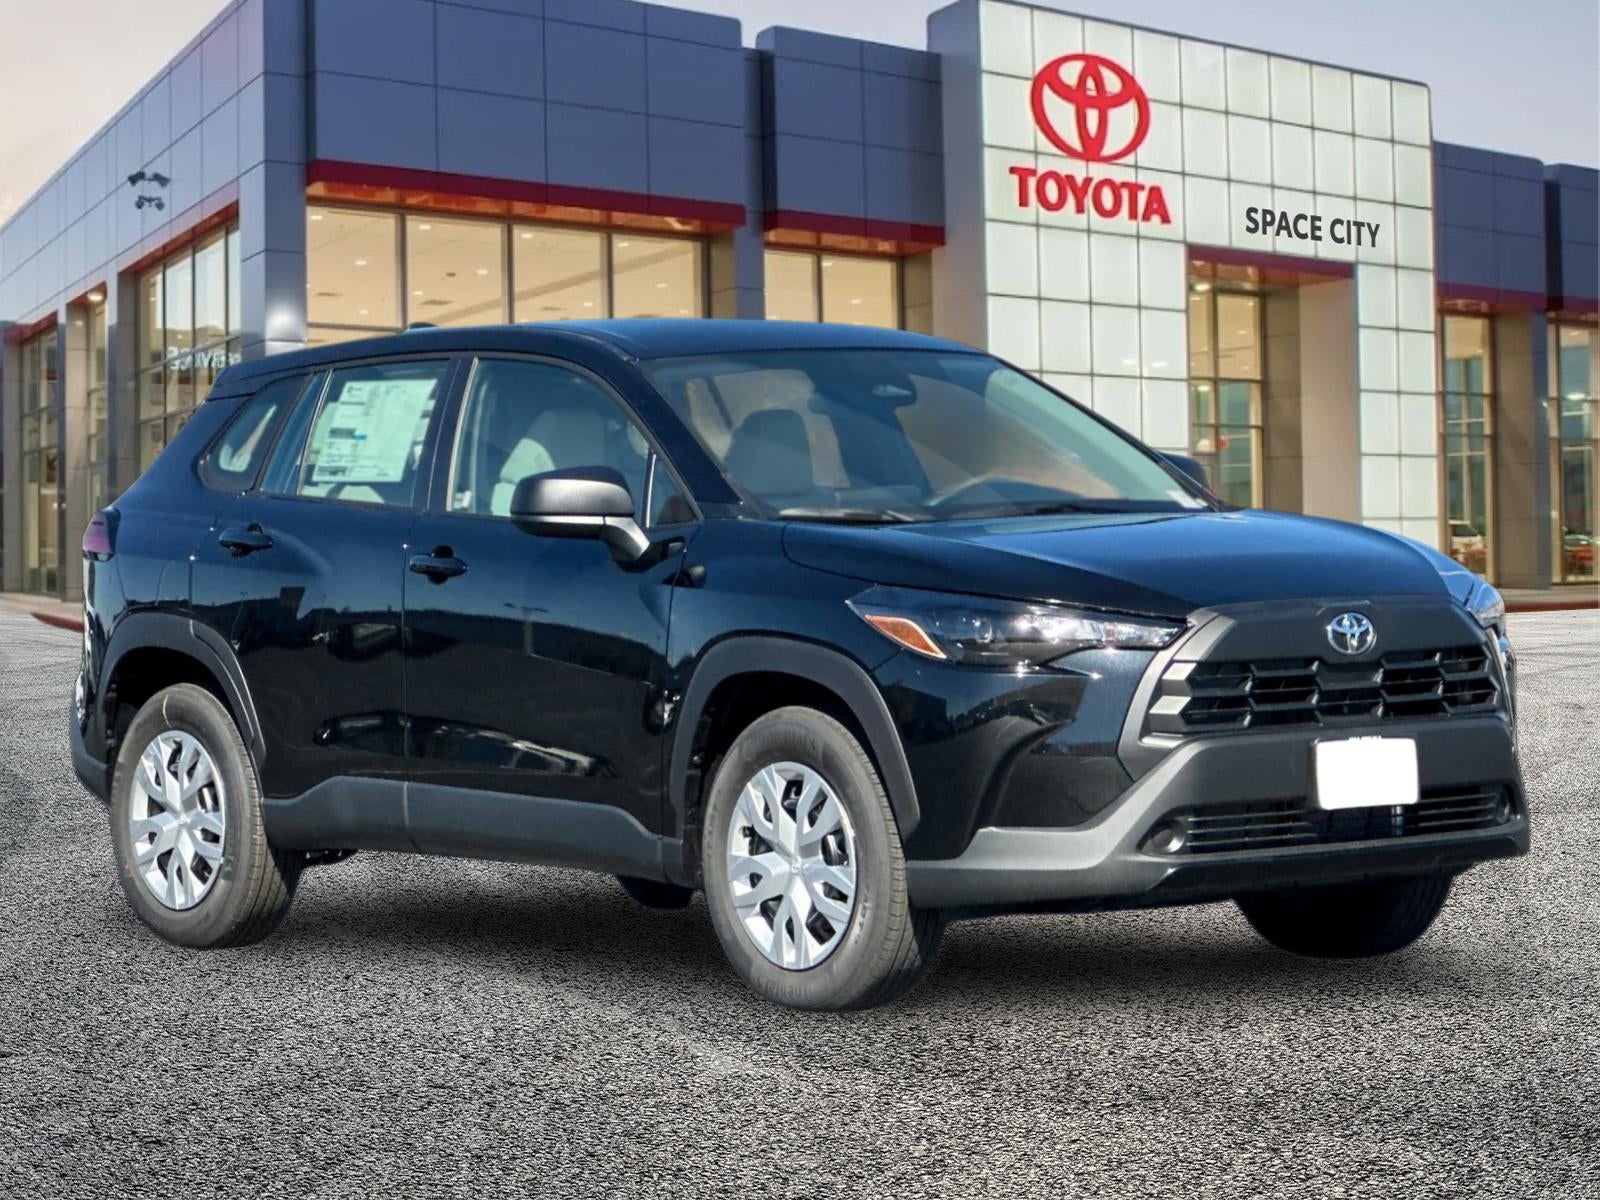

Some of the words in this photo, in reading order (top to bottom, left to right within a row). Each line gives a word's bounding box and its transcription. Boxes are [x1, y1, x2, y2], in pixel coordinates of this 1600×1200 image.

[1009, 166, 1171, 224] TOYOTA
[1245, 207, 1322, 242] SPACE
[1330, 218, 1380, 248] CITY
